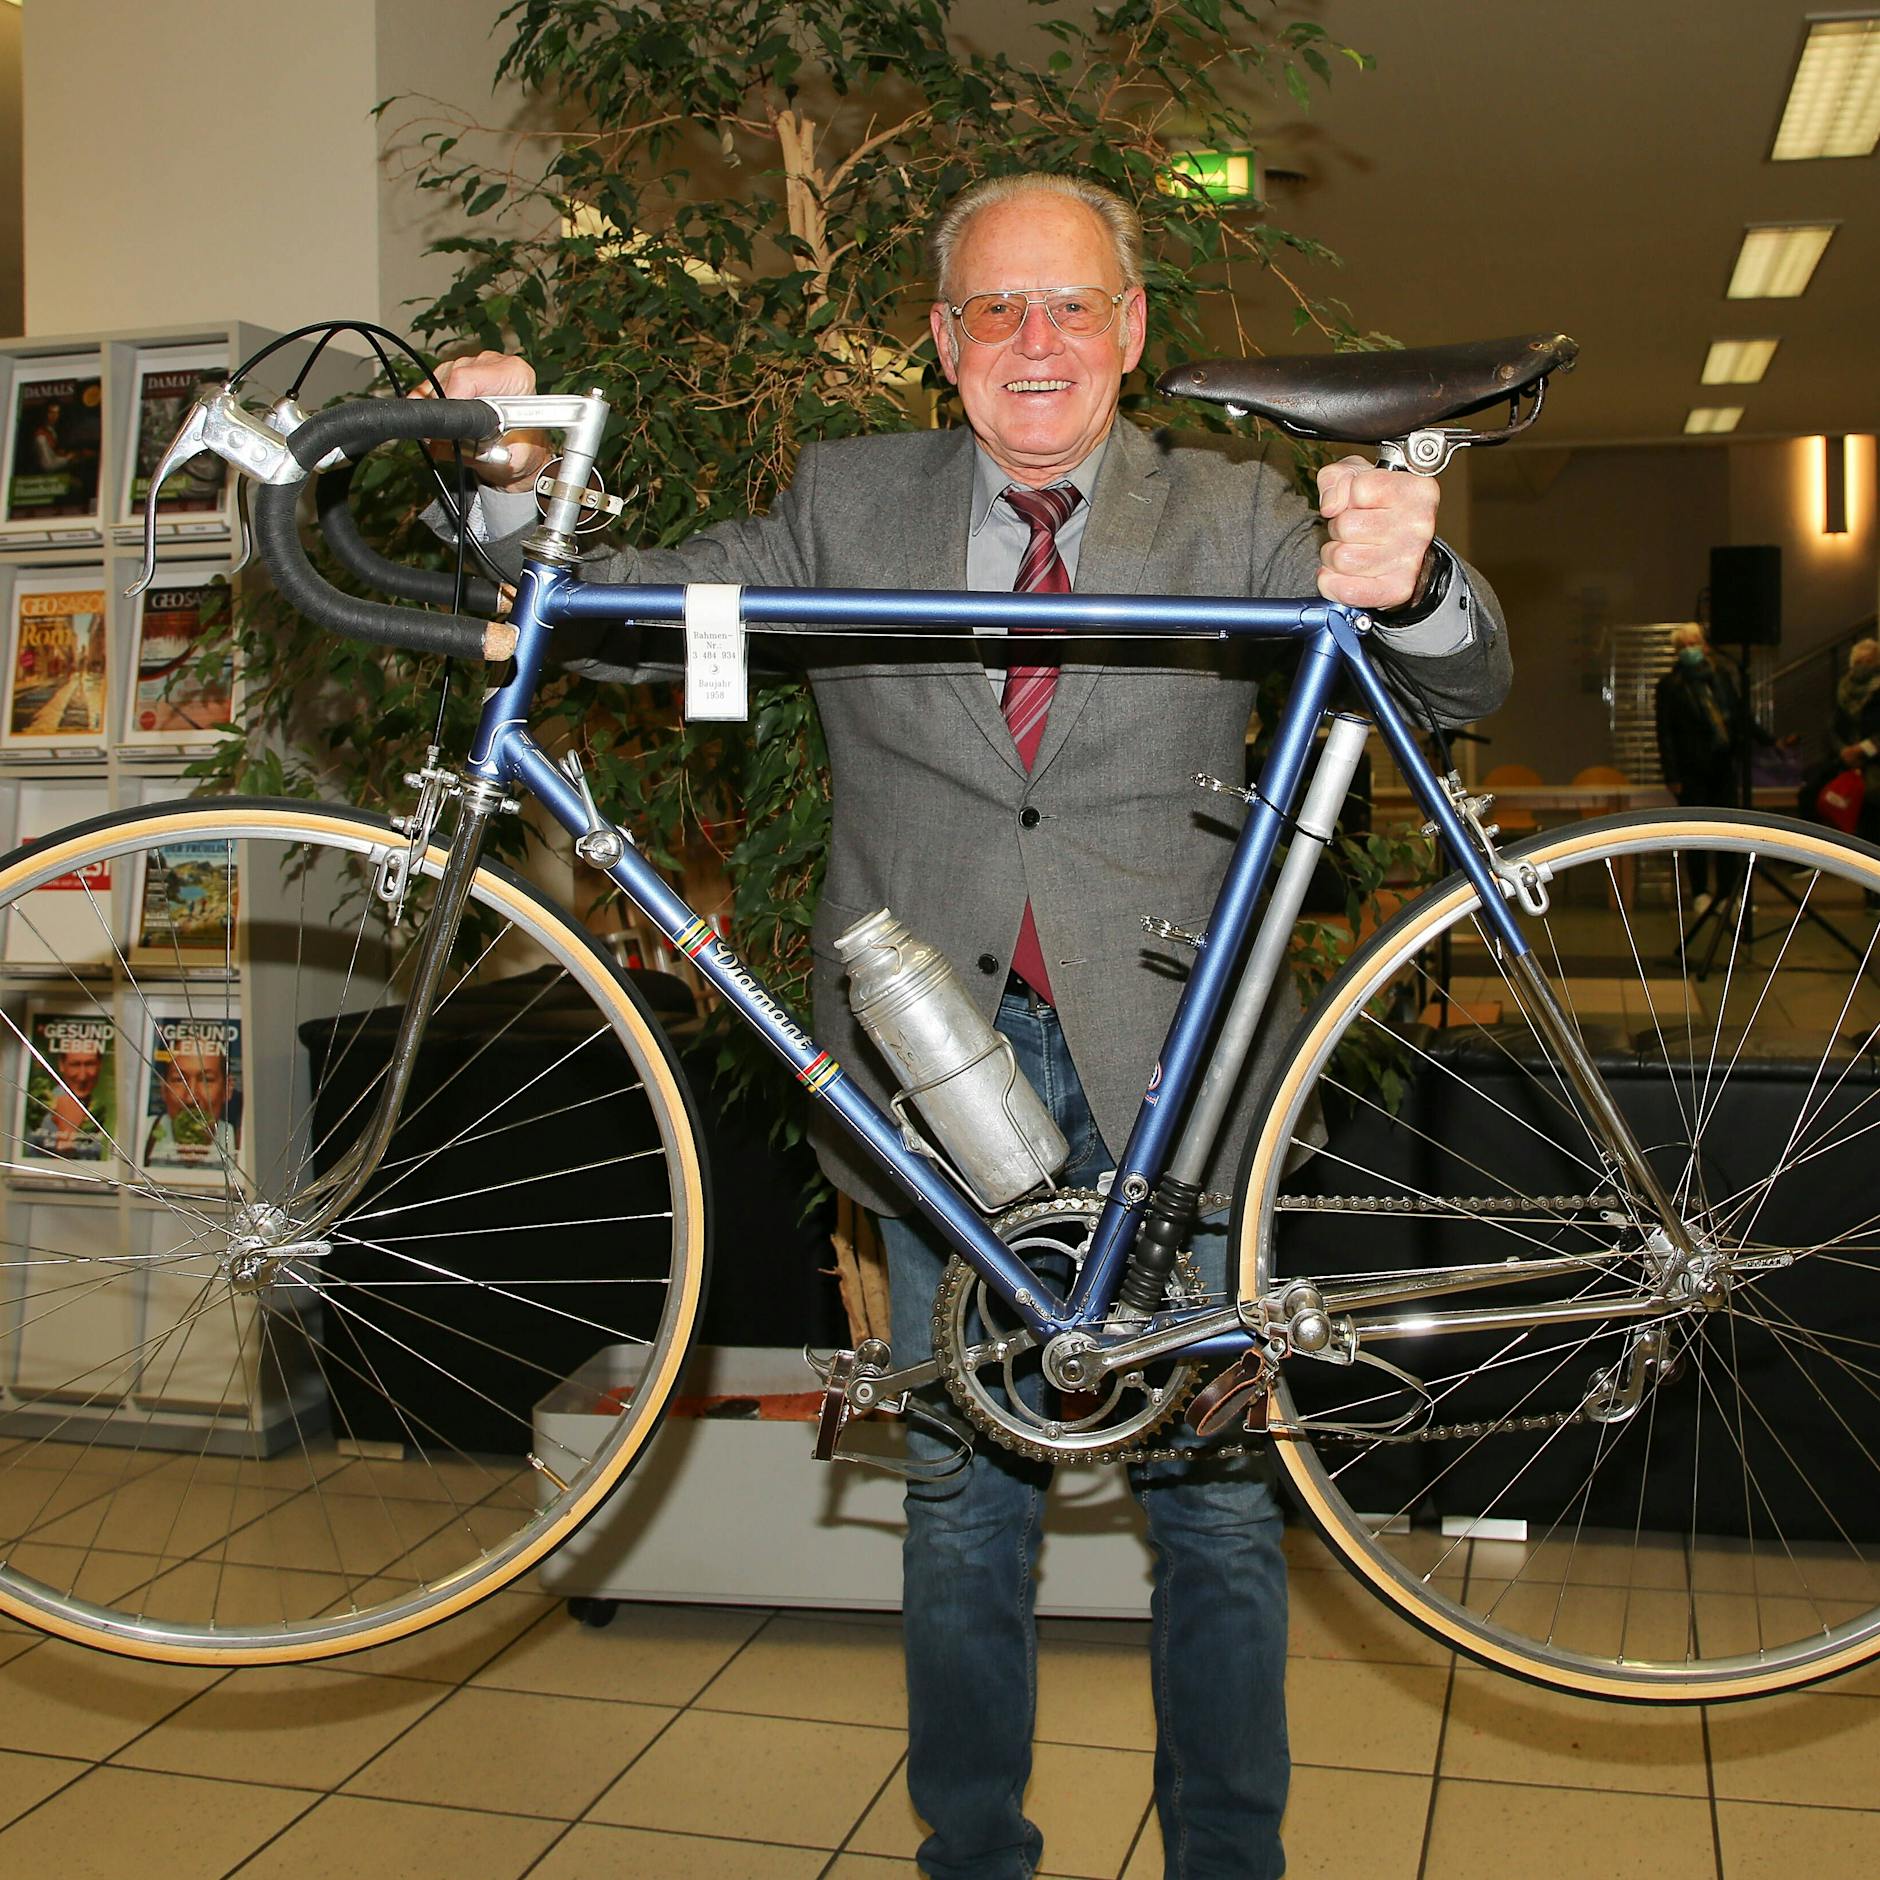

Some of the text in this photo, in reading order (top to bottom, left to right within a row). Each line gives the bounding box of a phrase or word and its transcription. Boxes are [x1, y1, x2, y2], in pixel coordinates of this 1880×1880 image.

[25, 383, 75, 399] DAMALS
[22, 624, 74, 647] Rom
[693, 631, 735, 640] Rahmen-
[706, 641, 722, 649] Nr.:
[692, 651, 698, 660] 3
[721, 651, 736, 660] 934
[698, 679, 731, 690] Baujahr
[706, 691, 725, 700] 1958
[711, 941, 813, 1051] Diamant
[44, 1023, 114, 1040] GESUND
[164, 1024, 239, 1042] GESUND
[49, 1038, 106, 1054] LEBEN
[169, 1039, 227, 1057] LEBEN
